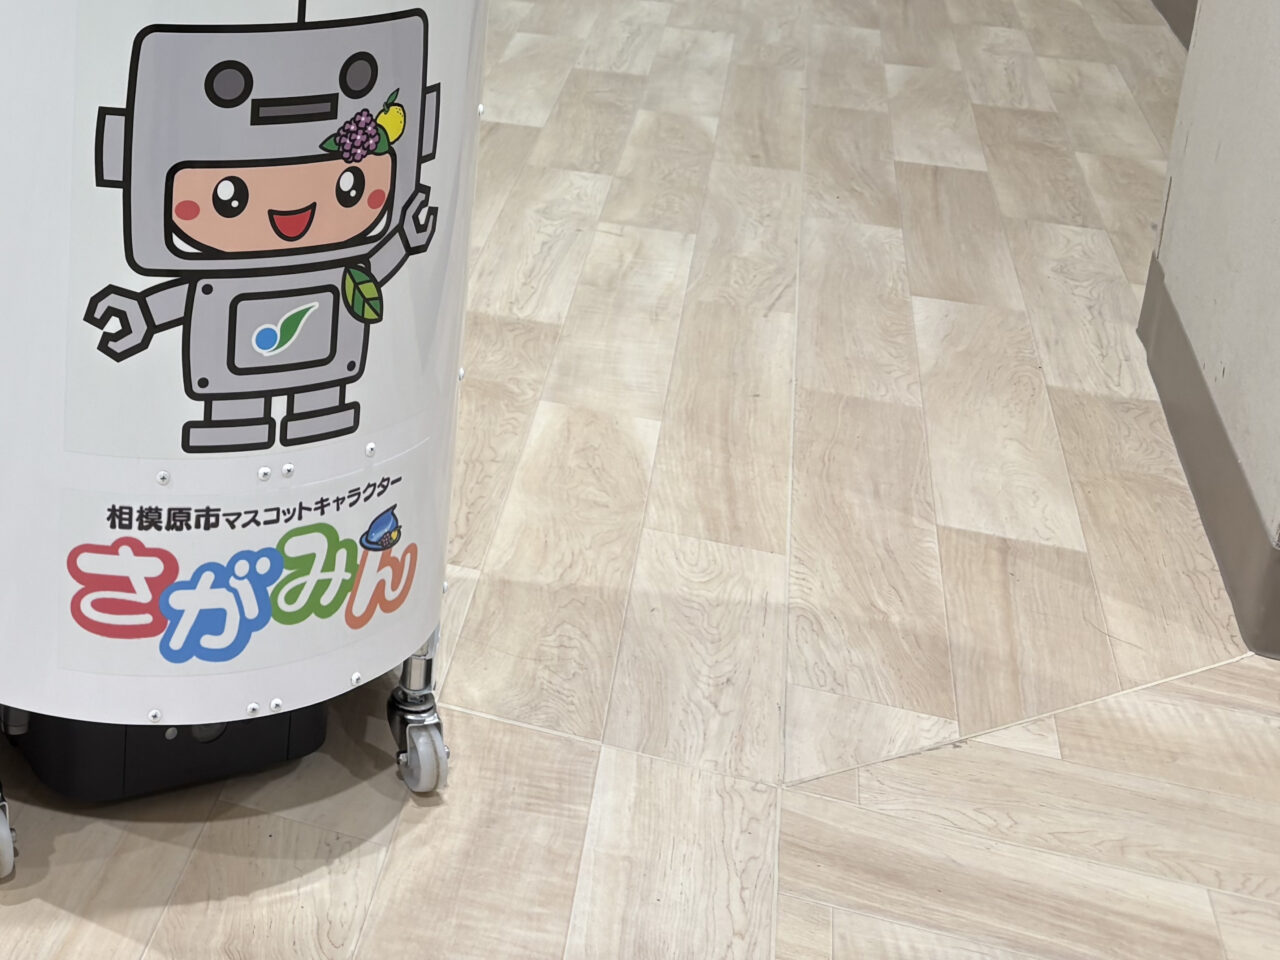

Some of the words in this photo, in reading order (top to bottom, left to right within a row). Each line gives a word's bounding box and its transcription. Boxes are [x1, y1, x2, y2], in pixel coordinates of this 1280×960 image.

[106, 475, 403, 532] 相模原市マスコットキャラクター
[66, 522, 418, 664] さがみん
